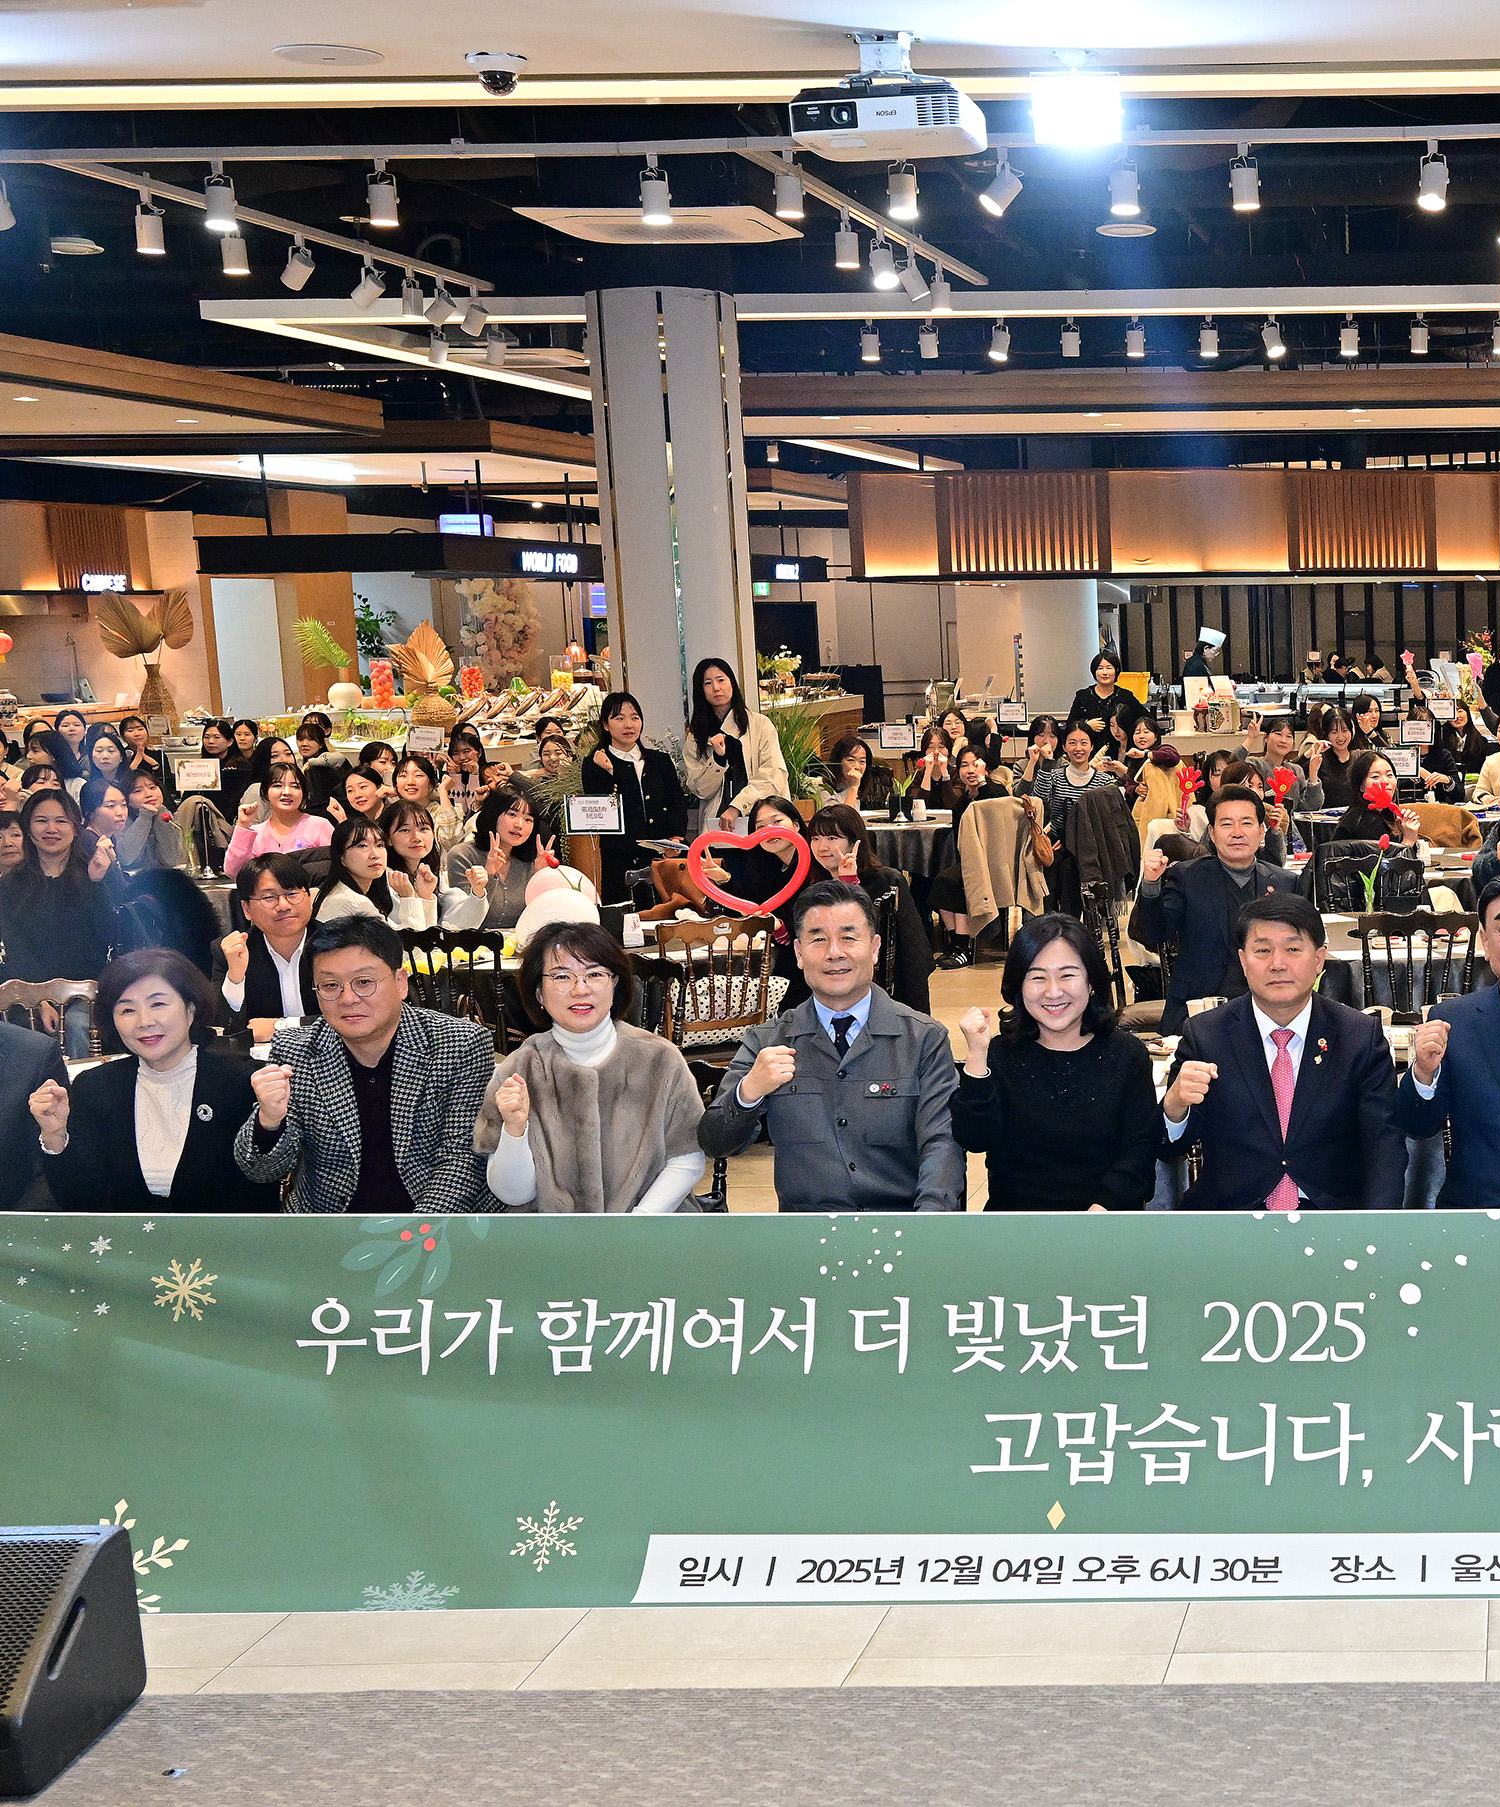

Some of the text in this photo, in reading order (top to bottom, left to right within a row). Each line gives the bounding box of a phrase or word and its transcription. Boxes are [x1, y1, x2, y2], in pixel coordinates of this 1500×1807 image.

[876, 109, 897, 117] EPSON
[521, 551, 578, 574] WORLD FOOD
[81, 573, 127, 592] CHINESE
[296, 1295, 1365, 1375] 우리가 함께여서 더 빛났던 2025
[970, 1402, 1372, 1487] 고맙습니다,
[680, 1557, 743, 1586] 일시
[797, 1556, 904, 1585] 2025년
[918, 1556, 982, 1584] 12월
[993, 1556, 1063, 1584] 04일
[1073, 1556, 1140, 1584] 오후
[1151, 1556, 1200, 1583] 6시
[1211, 1557, 1282, 1582] 30분
[1330, 1556, 1395, 1583] 장소
